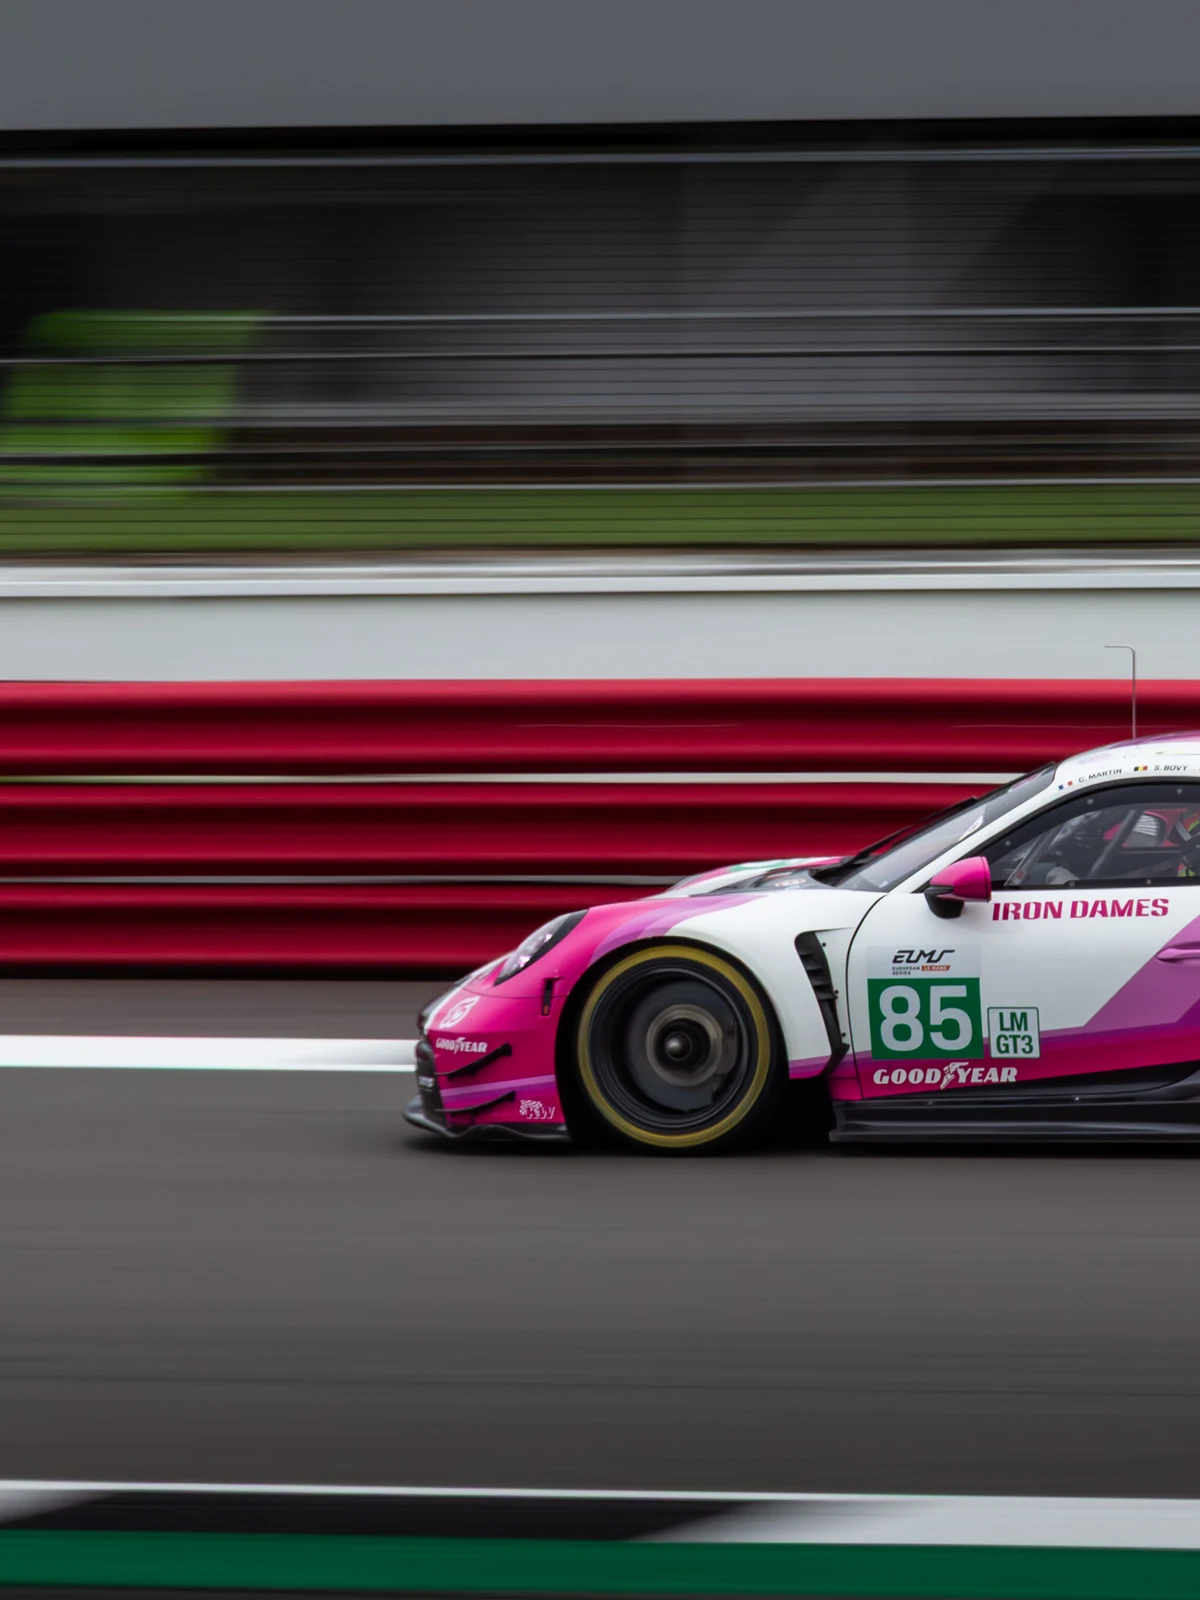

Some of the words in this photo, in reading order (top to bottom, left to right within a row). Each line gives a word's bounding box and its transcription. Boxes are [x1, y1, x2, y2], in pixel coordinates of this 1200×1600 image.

[1088, 768, 1122, 781] MARTIN
[1154, 764, 1162, 772] S.
[1164, 764, 1188, 772] BOVY
[992, 900, 1063, 921] IRON
[1070, 898, 1170, 918] DAMES
[879, 985, 973, 1052] 85
[998, 1011, 1029, 1032] LM
[435, 1037, 488, 1053] GOODYEAR
[996, 1034, 1034, 1055] GT3
[873, 1064, 1018, 1087] GOODYEAR
